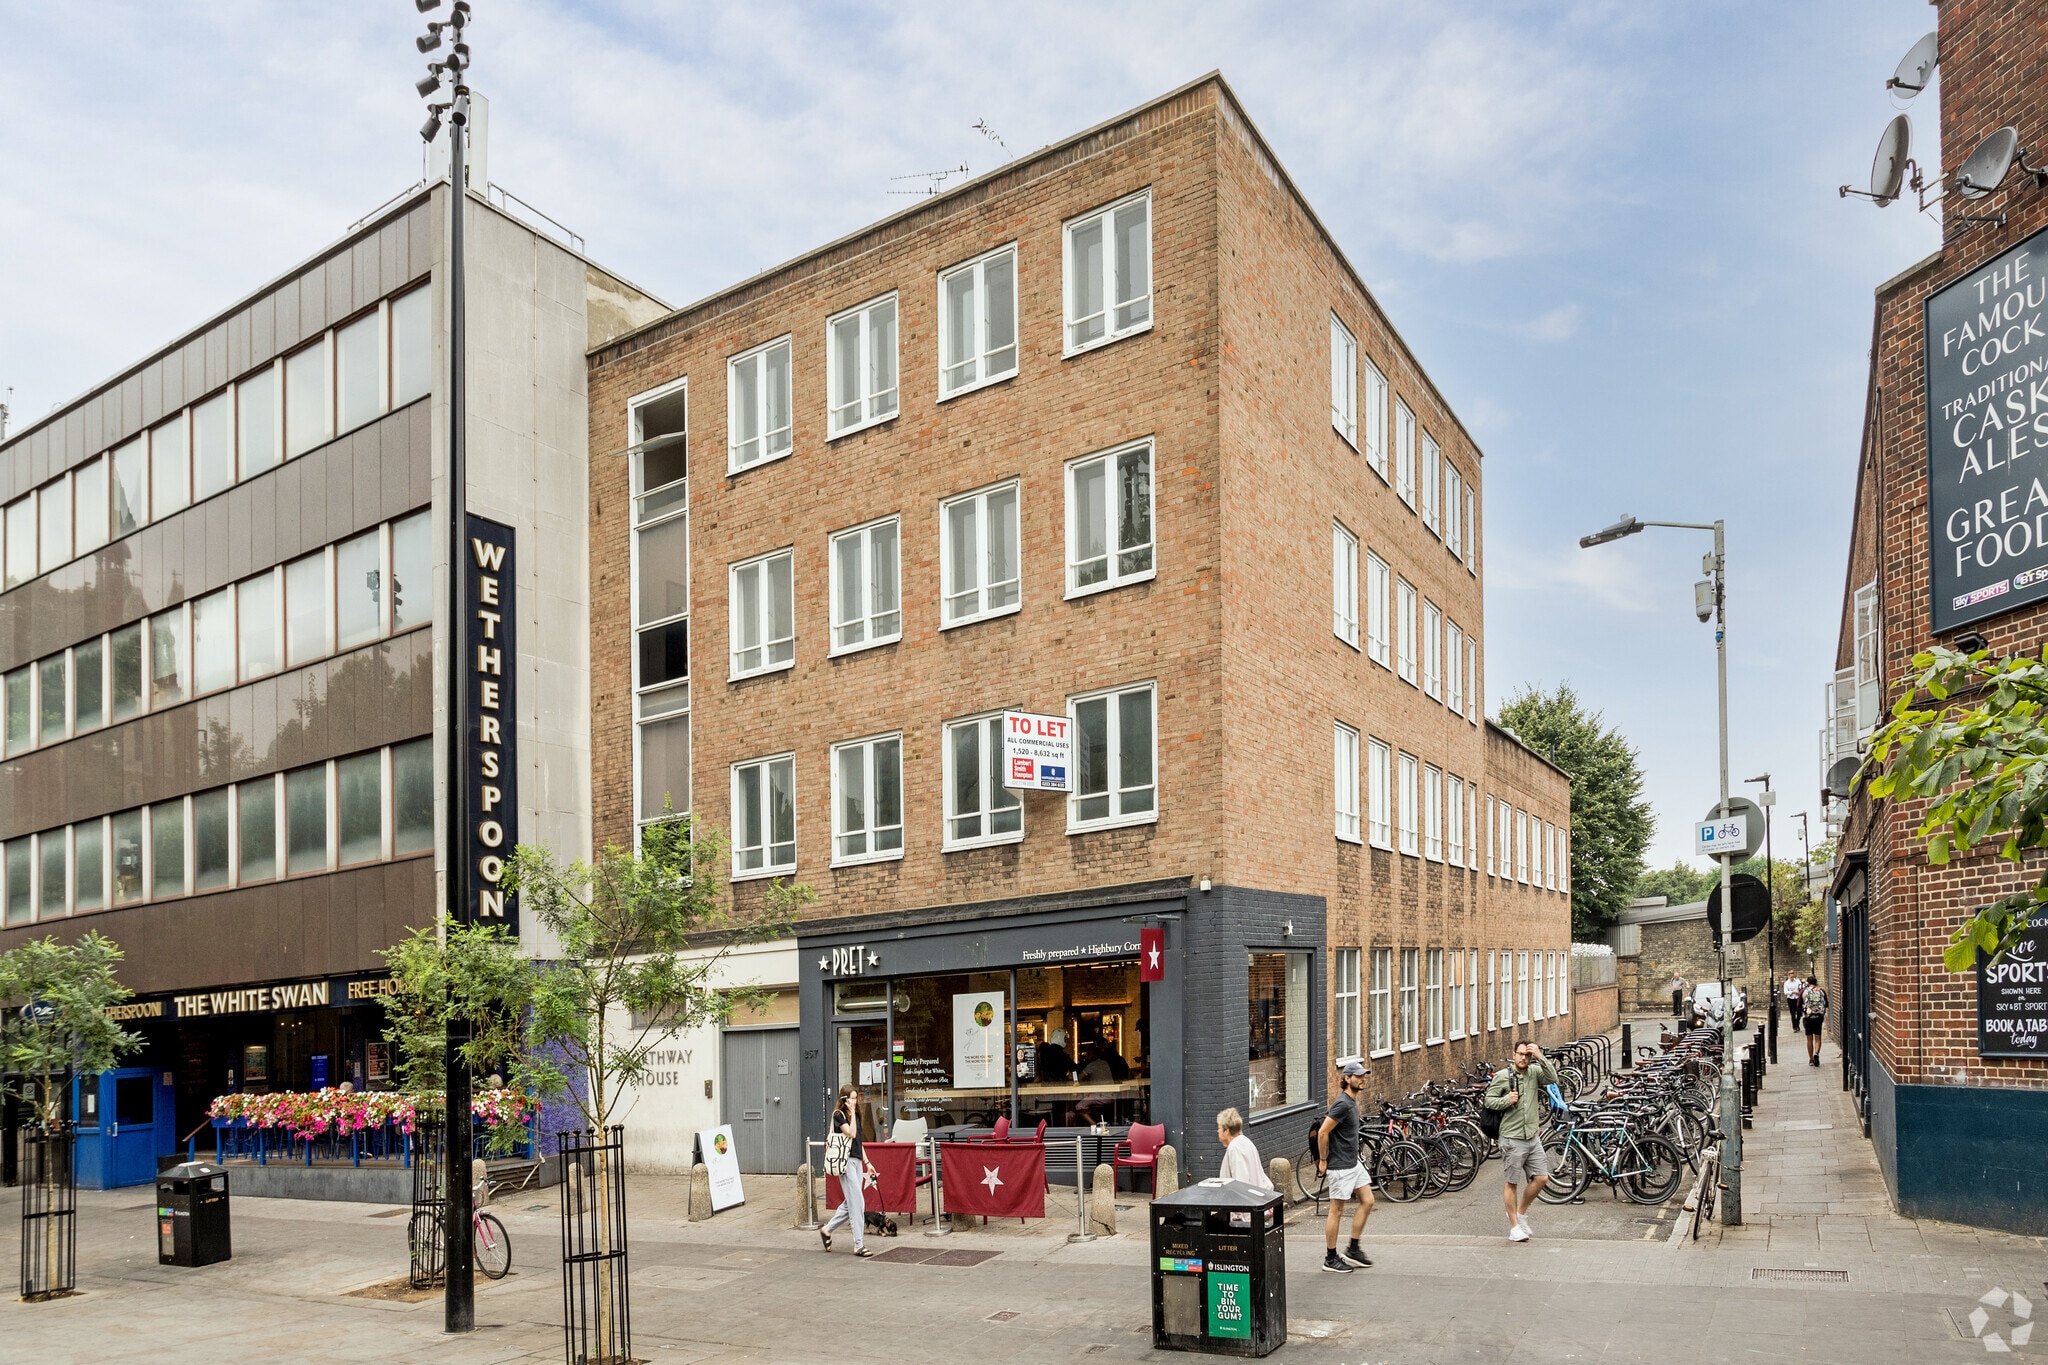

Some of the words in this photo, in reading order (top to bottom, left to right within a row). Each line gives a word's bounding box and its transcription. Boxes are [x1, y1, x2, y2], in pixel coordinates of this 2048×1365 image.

[1973, 252, 2030, 305] THE
[1962, 312, 2046, 376] COCK
[2020, 572, 2034, 585] BT
[1970, 582, 2007, 603] SPORTS
[471, 536, 506, 918] WETHERSPOON
[1009, 716, 1031, 734] TO
[1037, 720, 1066, 738] LET
[1019, 738, 1054, 747] COMMERCIAL
[1704, 828, 1712, 840] P
[1022, 949, 1046, 960] Freshly
[1048, 946, 1079, 959] prepared
[1088, 942, 1122, 956] Highbury
[832, 946, 865, 976] PRET
[1986, 962, 2048, 984] SPORT
[348, 980, 378, 999] FREE
[174, 993, 209, 1018] THE
[210, 988, 271, 1014] WHITE
[271, 981, 330, 1010] SWAN
[1986, 1019, 2014, 1032] BOOK
[2016, 1019, 2024, 1032] A
[2010, 1030, 2037, 1048] today
[920, 1057, 939, 1066] Prepared
[636, 1071, 678, 1086] HOUSE
[1214, 1263, 1249, 1272] ISLINGTON
[1218, 1283, 1239, 1292] TIME
[1216, 1304, 1240, 1313] YOUR
[1221, 1298, 1236, 1306] BIN
[1218, 1312, 1242, 1320] GUM?
